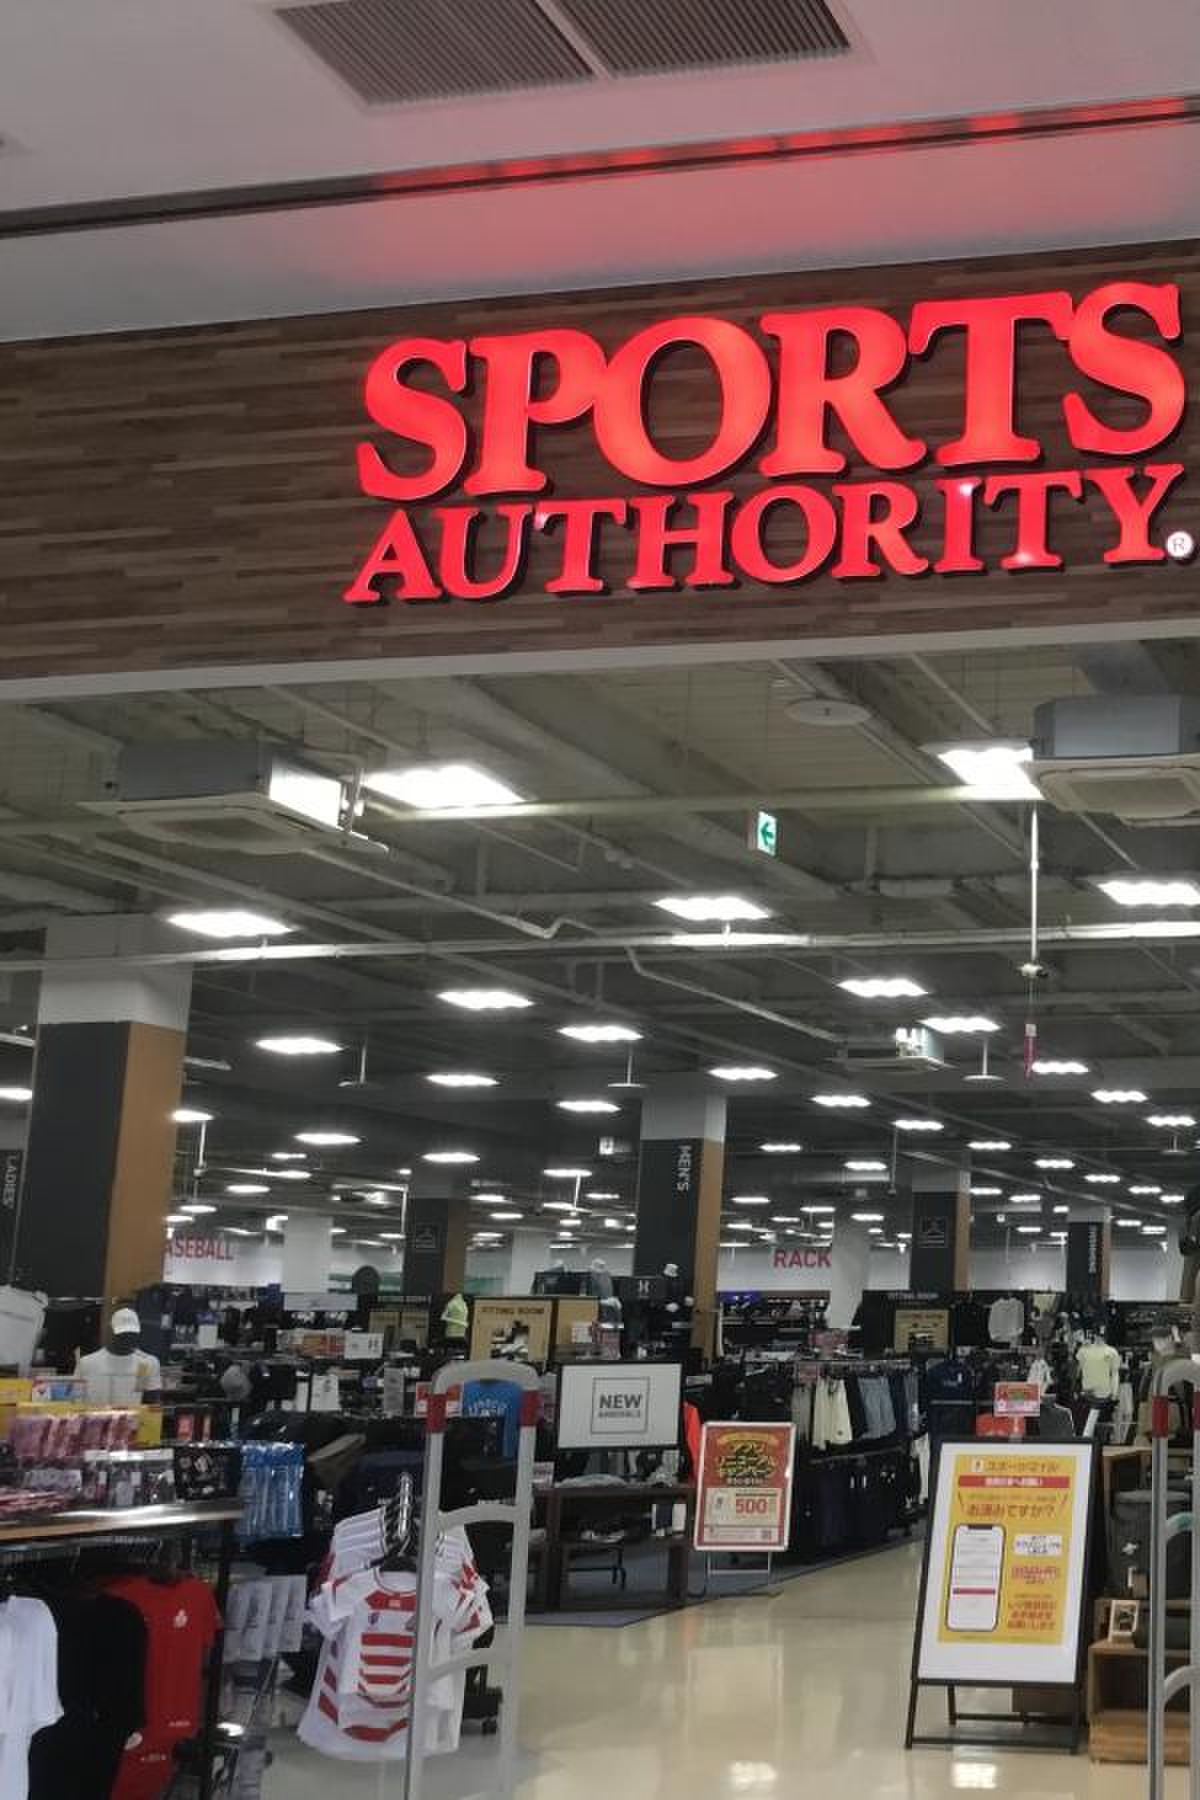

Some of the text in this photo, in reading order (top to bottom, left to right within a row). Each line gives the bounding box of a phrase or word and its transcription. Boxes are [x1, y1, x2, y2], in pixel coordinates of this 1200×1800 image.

[355, 280, 1187, 502] SPORTS
[342, 463, 1187, 605] AUTHORITY
[165, 1236, 234, 1260] ASEBALL
[773, 1249, 832, 1268] RACK
[599, 1393, 643, 1409] NEW
[735, 1498, 768, 1514] 500
